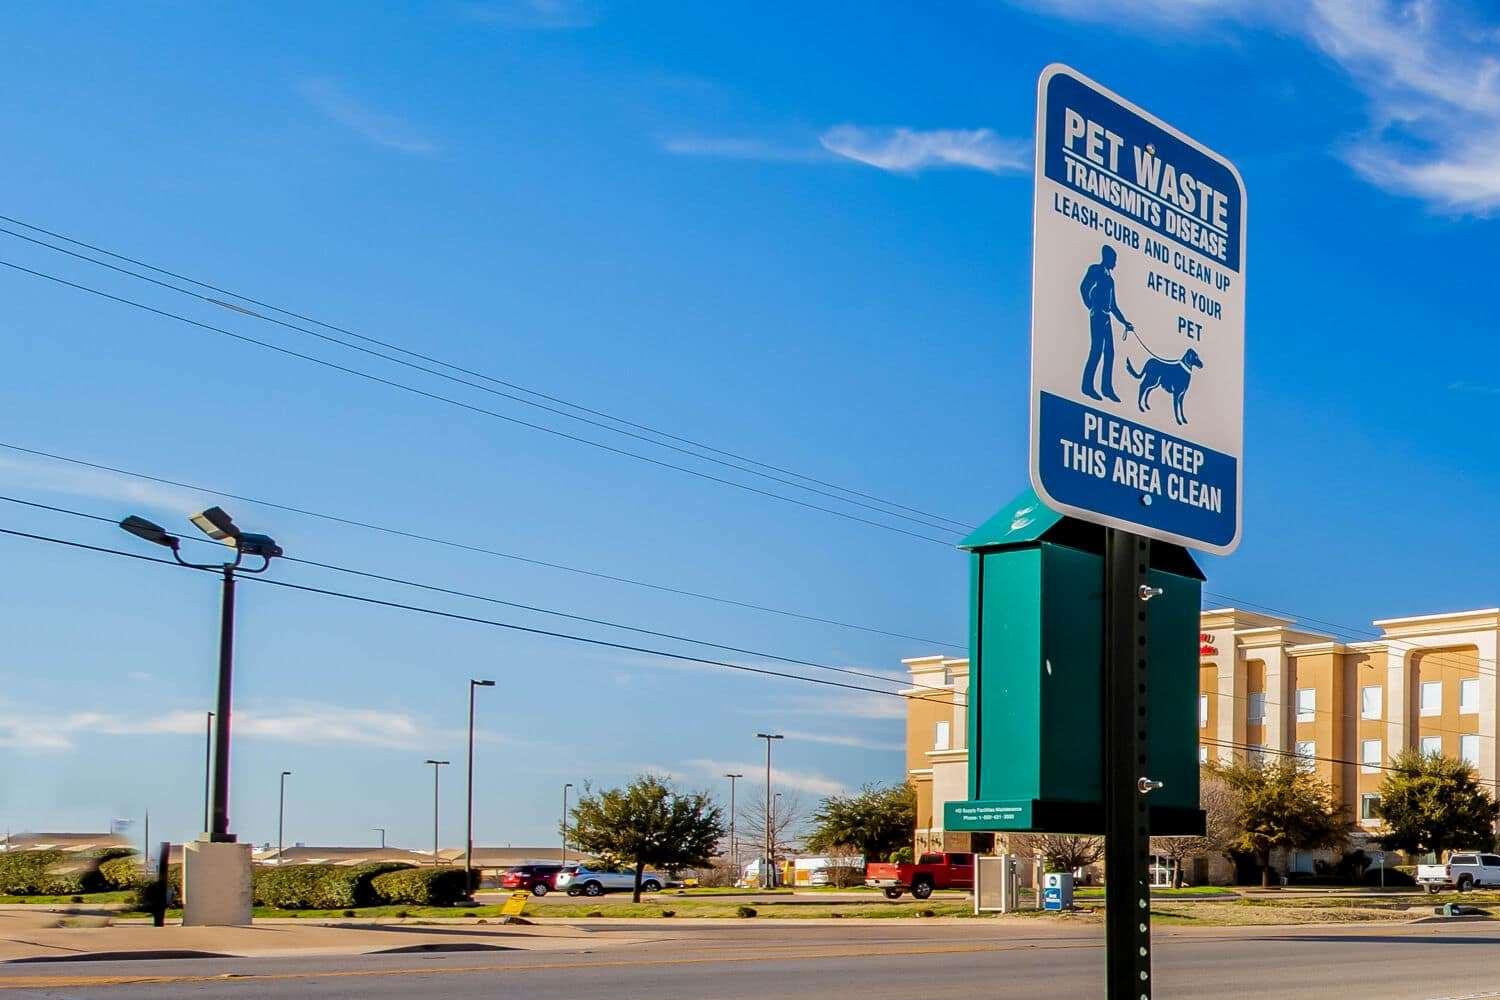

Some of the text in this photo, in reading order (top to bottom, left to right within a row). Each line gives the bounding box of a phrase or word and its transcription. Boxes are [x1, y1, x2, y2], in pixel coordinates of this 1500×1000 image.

[1064, 107, 1228, 232] PET WASTE
[1055, 192, 1231, 292] LEASH-CURB AND CLEAN UP
[1064, 156, 1227, 261] TRANSMITS DISEASE
[1147, 271, 1222, 320] AFTER YOUR
[1178, 316, 1203, 342] PET
[1060, 438, 1222, 514] THIS AREA CLEAN
[1084, 412, 1205, 475] PLEASE KEEP
